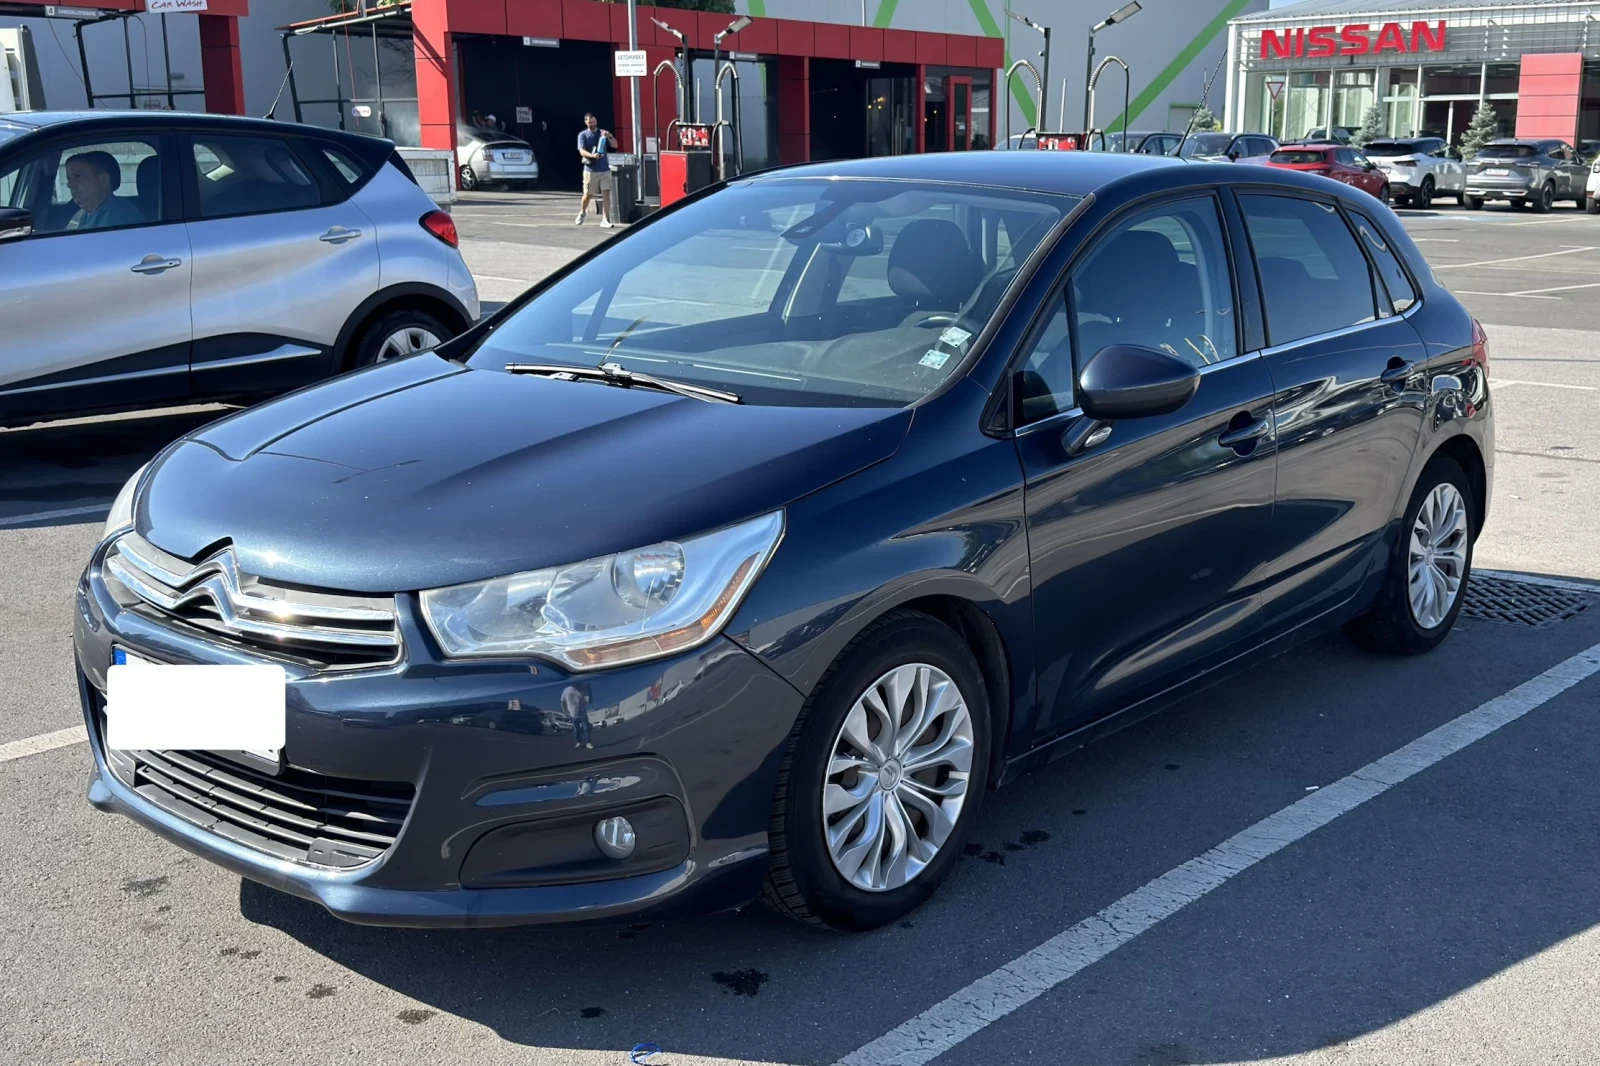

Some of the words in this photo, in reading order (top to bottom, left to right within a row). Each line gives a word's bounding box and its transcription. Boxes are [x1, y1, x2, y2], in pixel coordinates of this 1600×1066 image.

[151, 1, 174, 9] CAR
[175, 0, 204, 8] WASH
[1260, 20, 1447, 60] NISSAN
